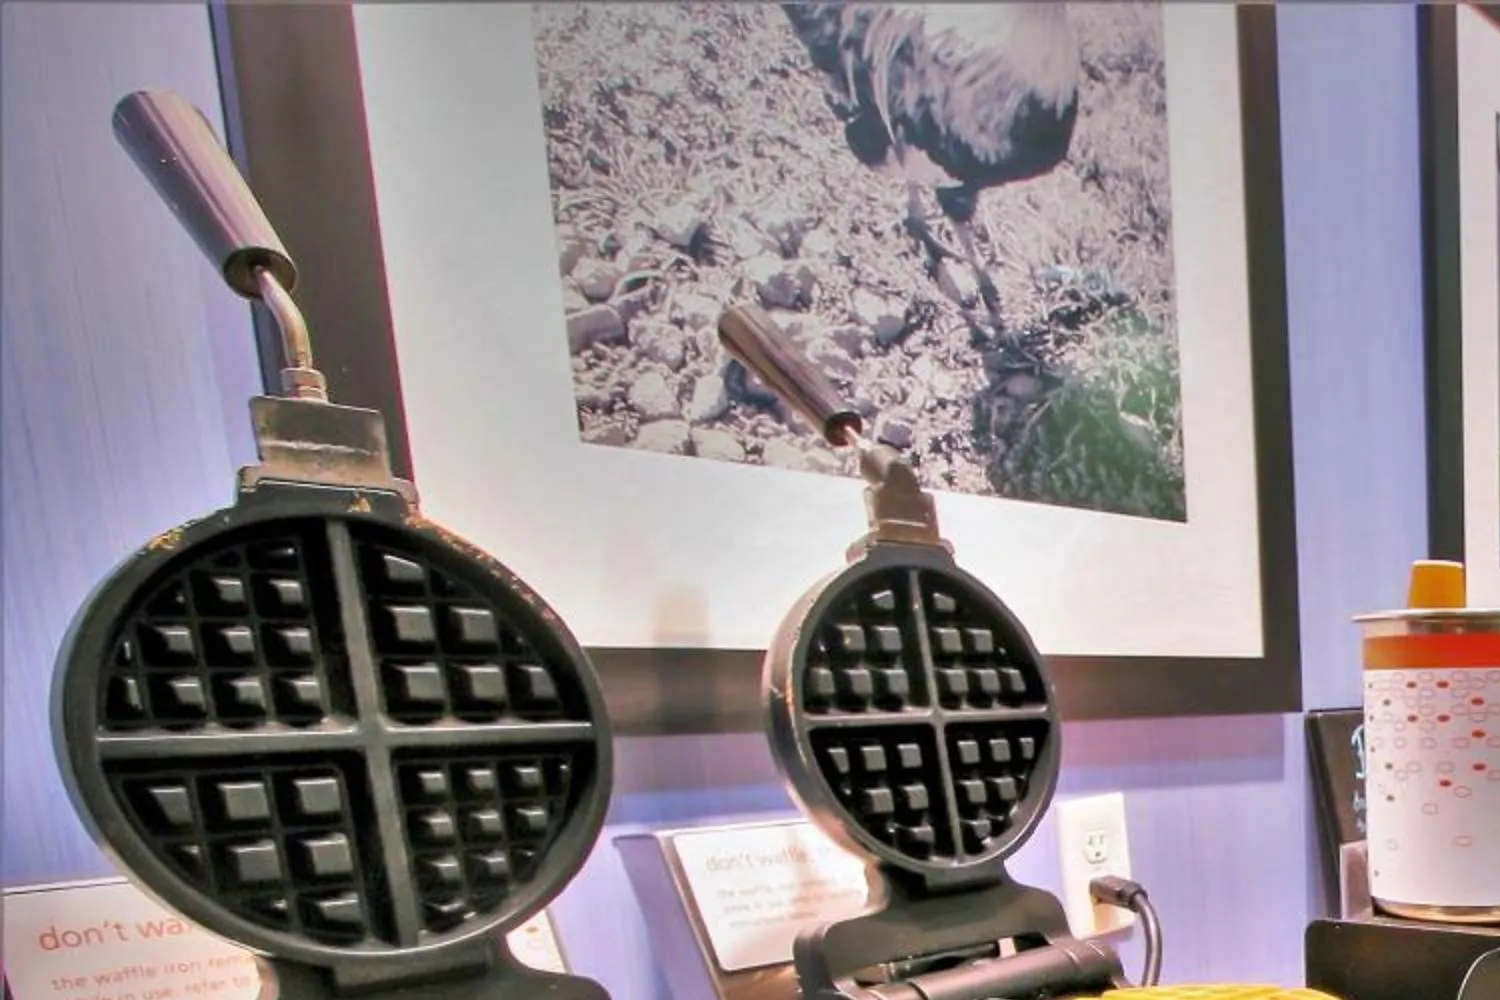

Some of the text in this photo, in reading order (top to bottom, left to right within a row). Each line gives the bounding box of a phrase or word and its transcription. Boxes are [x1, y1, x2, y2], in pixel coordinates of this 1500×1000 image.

[38, 919, 129, 951] don't
[51, 977, 88, 990] the
[94, 963, 158, 987] waffle
